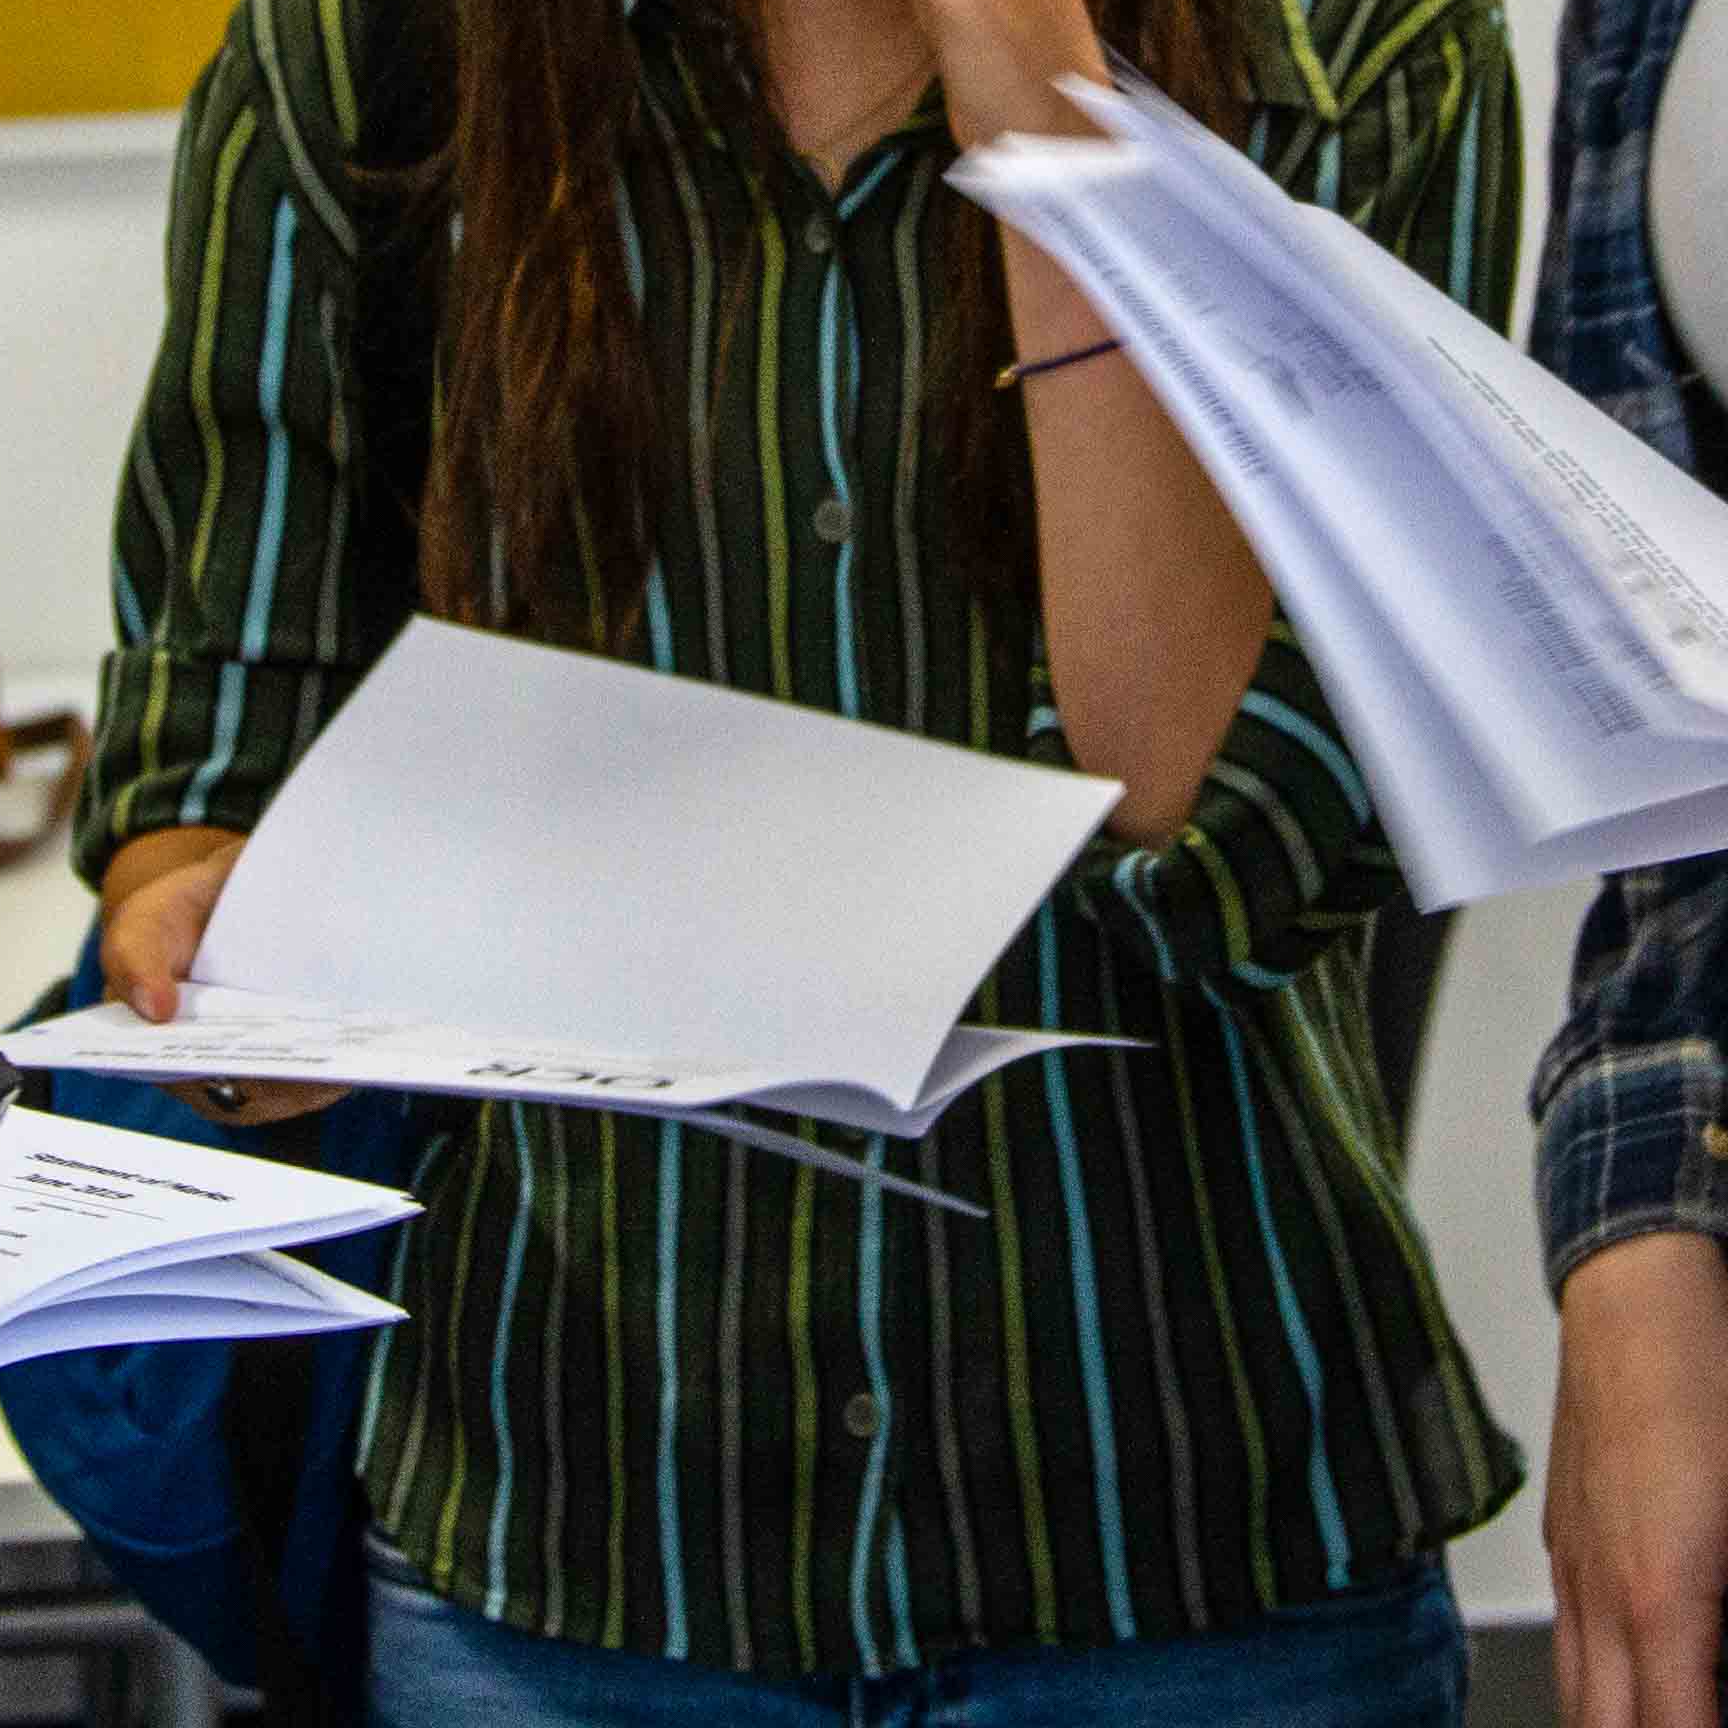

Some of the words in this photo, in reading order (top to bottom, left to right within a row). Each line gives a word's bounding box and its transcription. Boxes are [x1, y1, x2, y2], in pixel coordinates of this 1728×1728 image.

[16, 1173, 72, 1188] June
[25, 1153, 140, 1180] Statement
[170, 1181, 236, 1203] Marks
